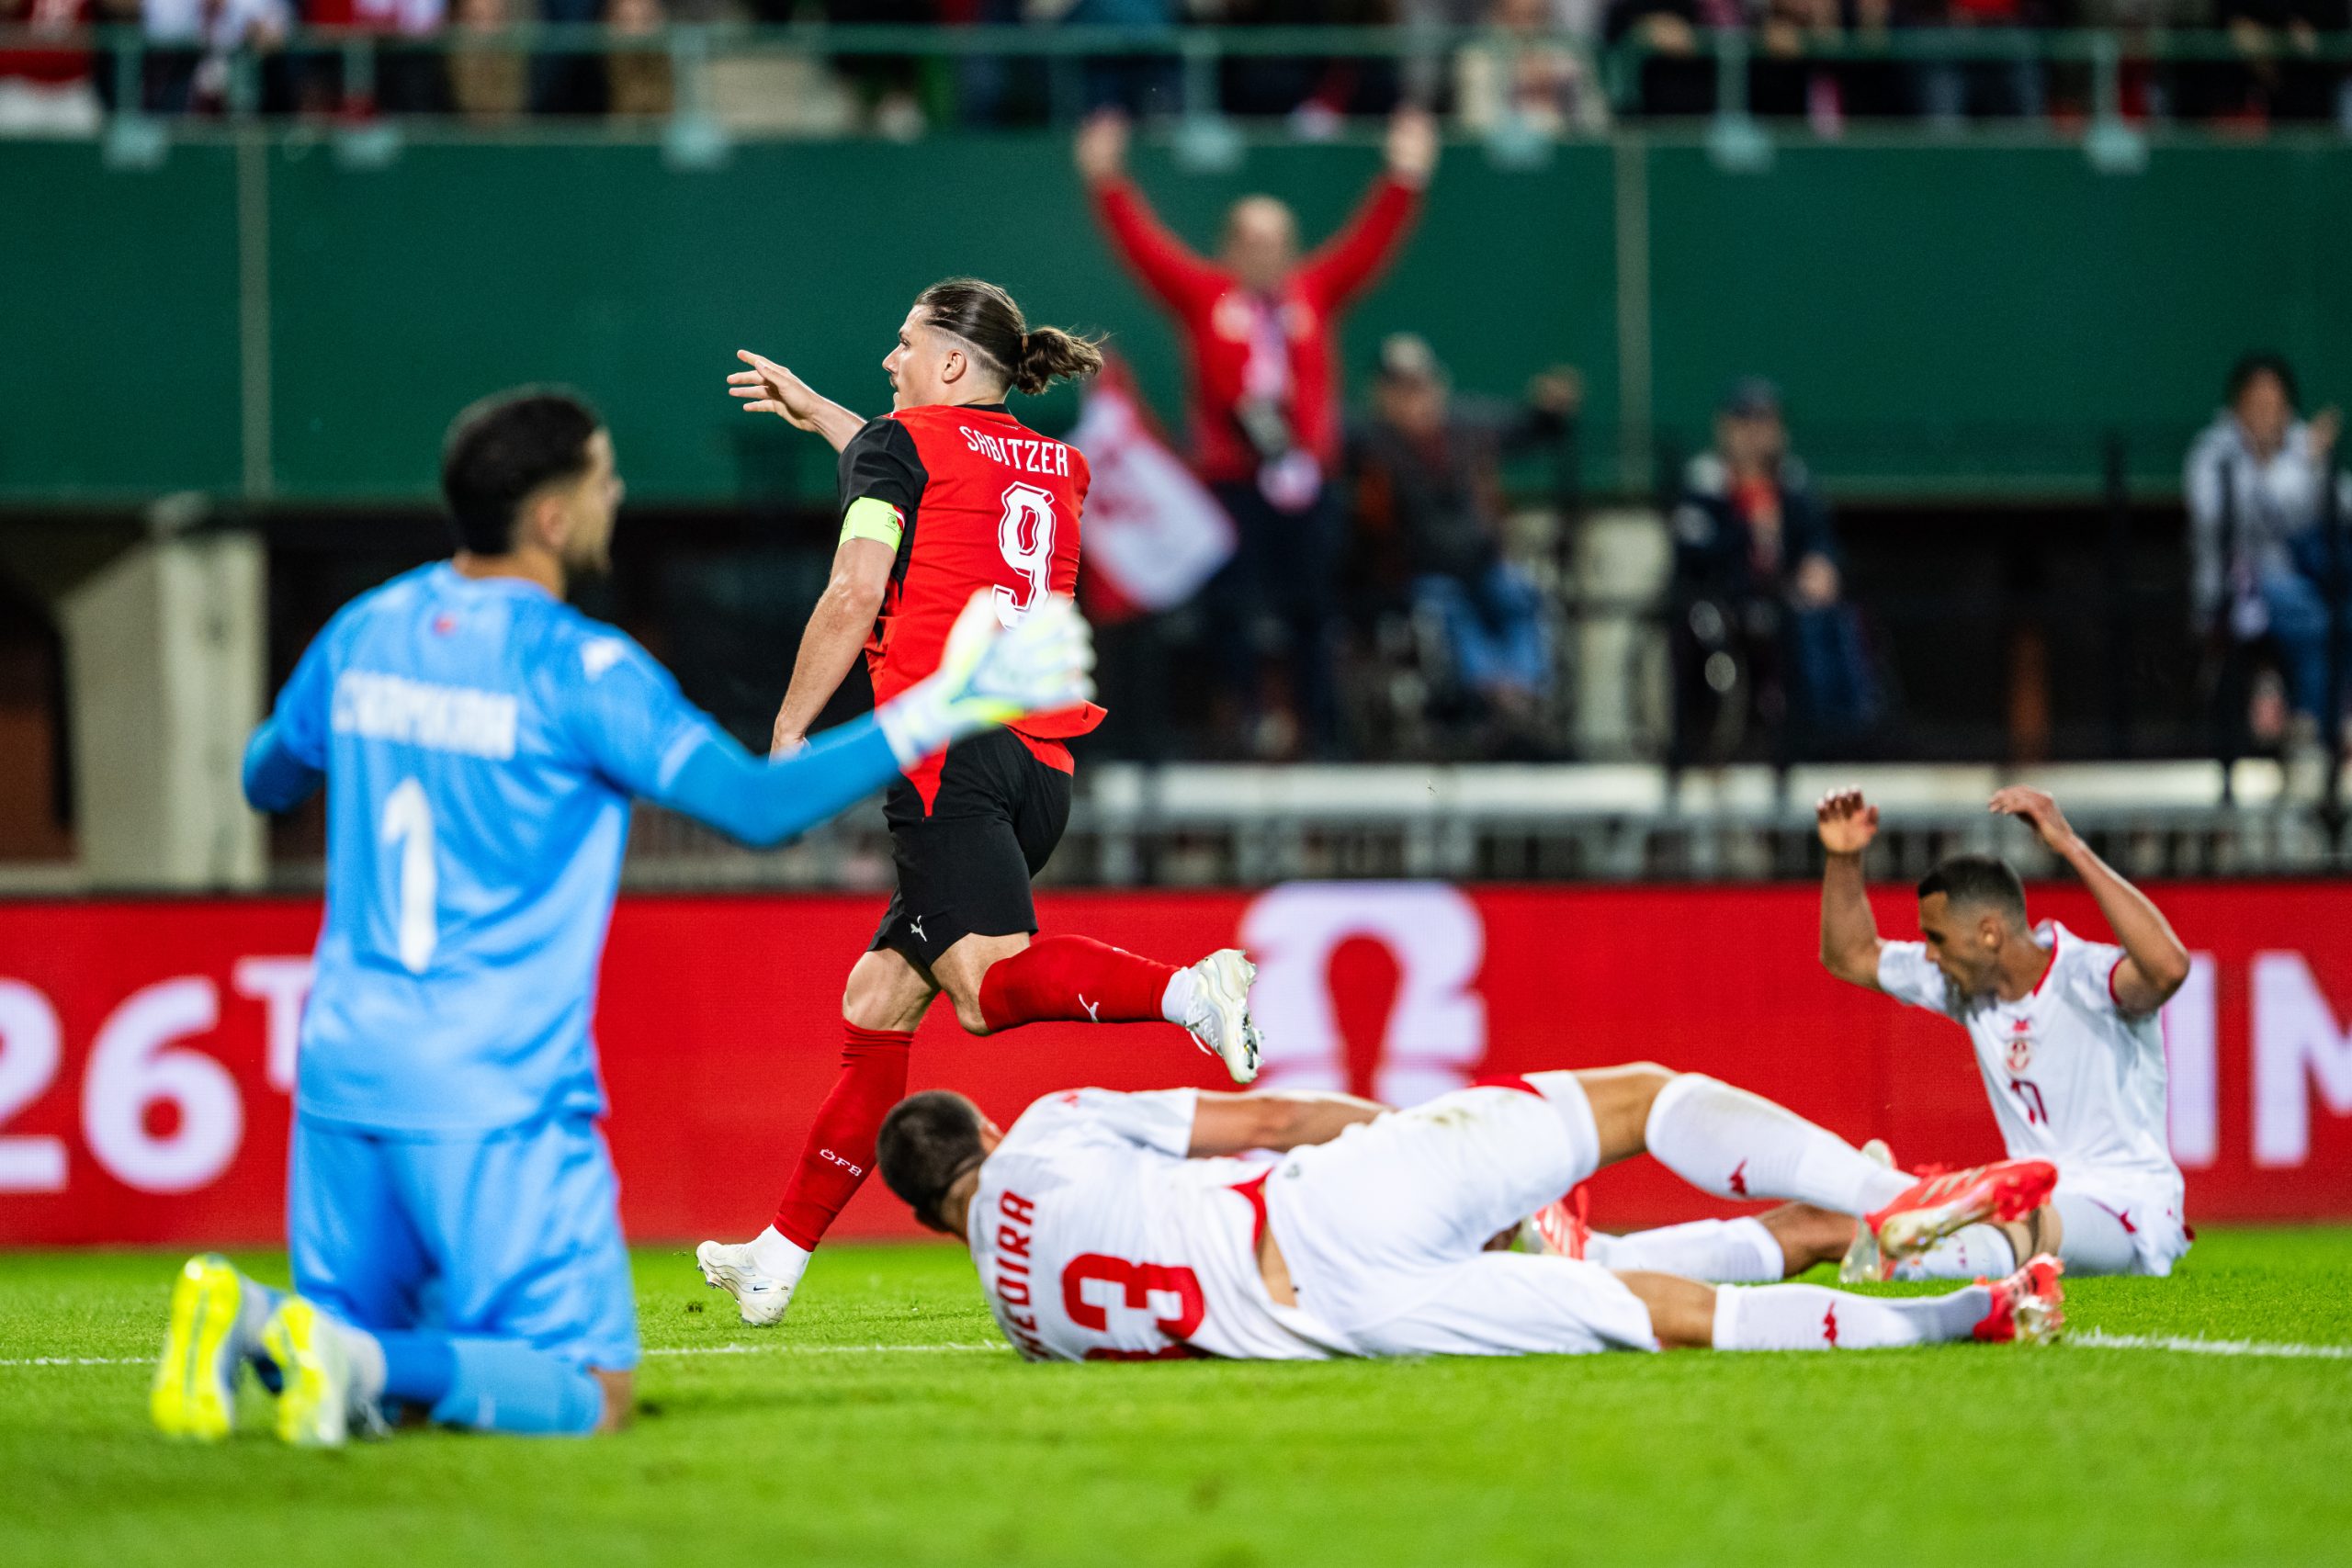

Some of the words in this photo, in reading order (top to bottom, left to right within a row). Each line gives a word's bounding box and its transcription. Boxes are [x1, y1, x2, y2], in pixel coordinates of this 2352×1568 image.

[959, 425, 1069, 477] SABITZER
[992, 480, 1057, 632] 9
[382, 777, 437, 974] 1
[819, 1148, 863, 1177] ÖFB
